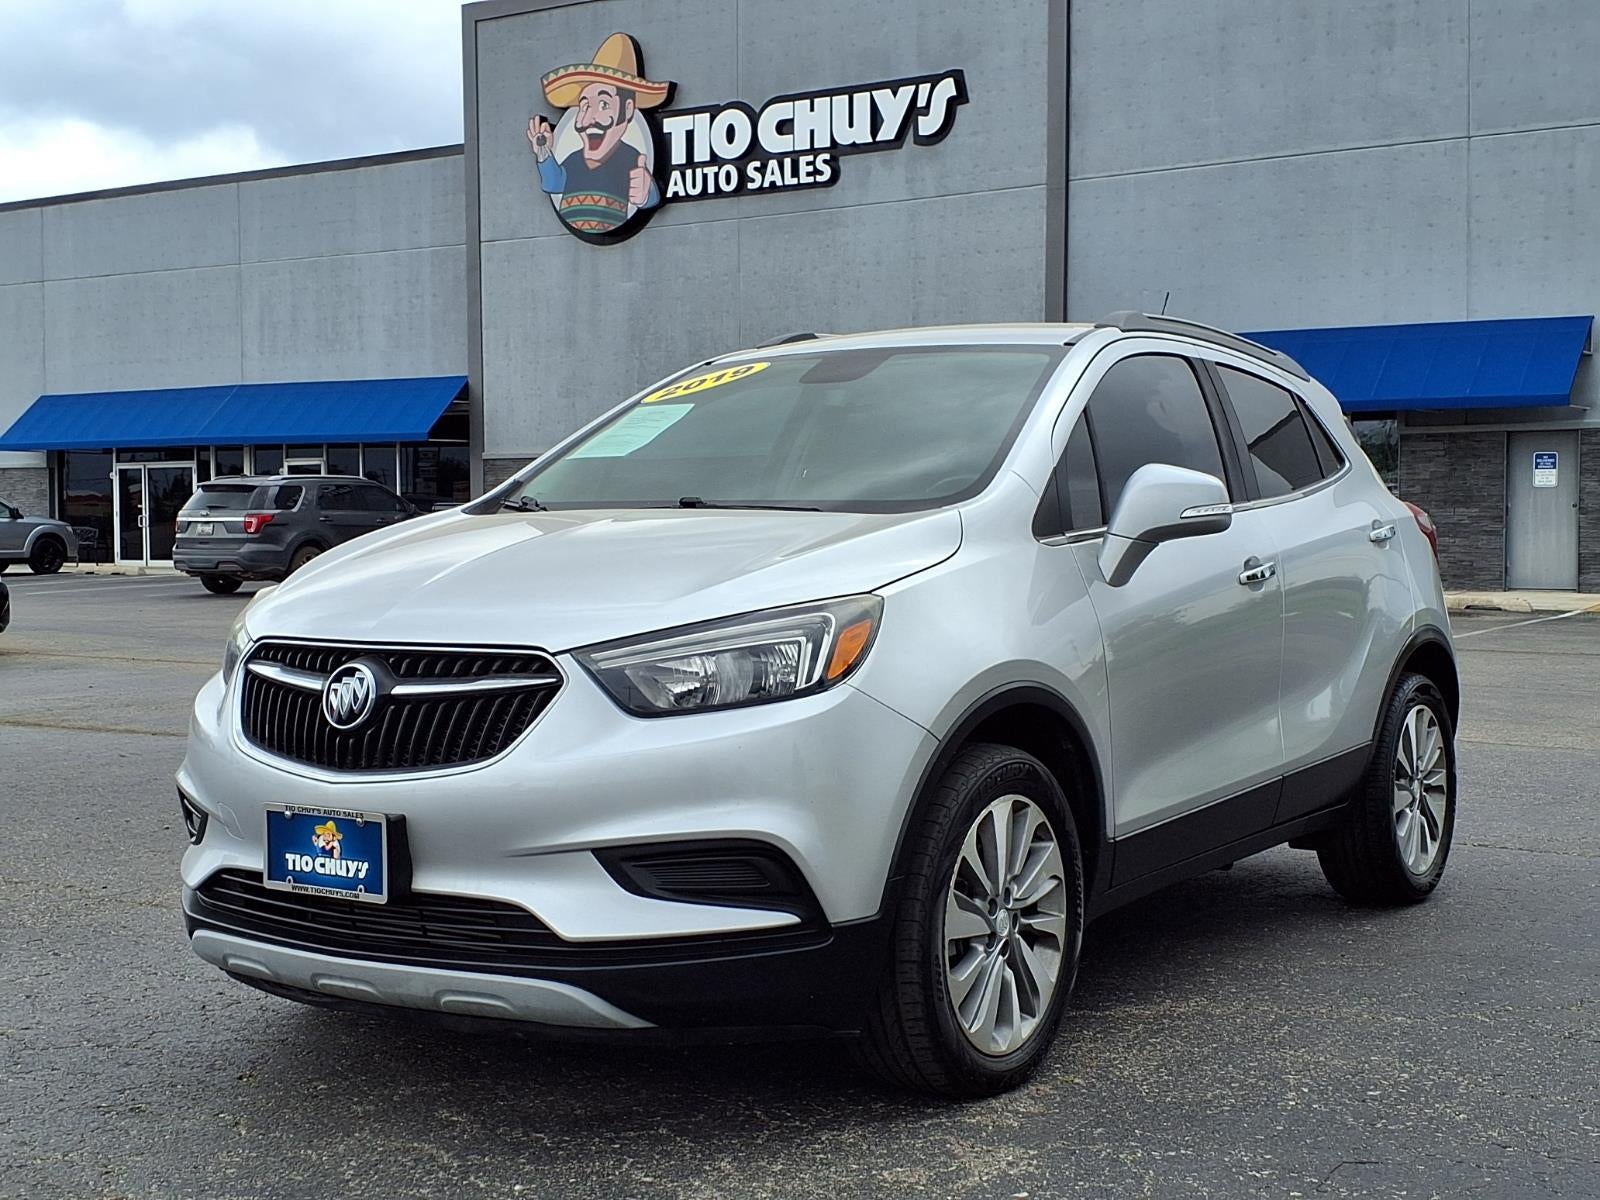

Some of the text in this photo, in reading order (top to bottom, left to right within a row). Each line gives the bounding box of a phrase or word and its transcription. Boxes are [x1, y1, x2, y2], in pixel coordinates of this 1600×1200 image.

[663, 77, 957, 165] TIO CHUY'S
[666, 153, 832, 198] AUTO SALES
[654, 366, 755, 400] 2019
[285, 853, 369, 879] TIO CHUY'S
